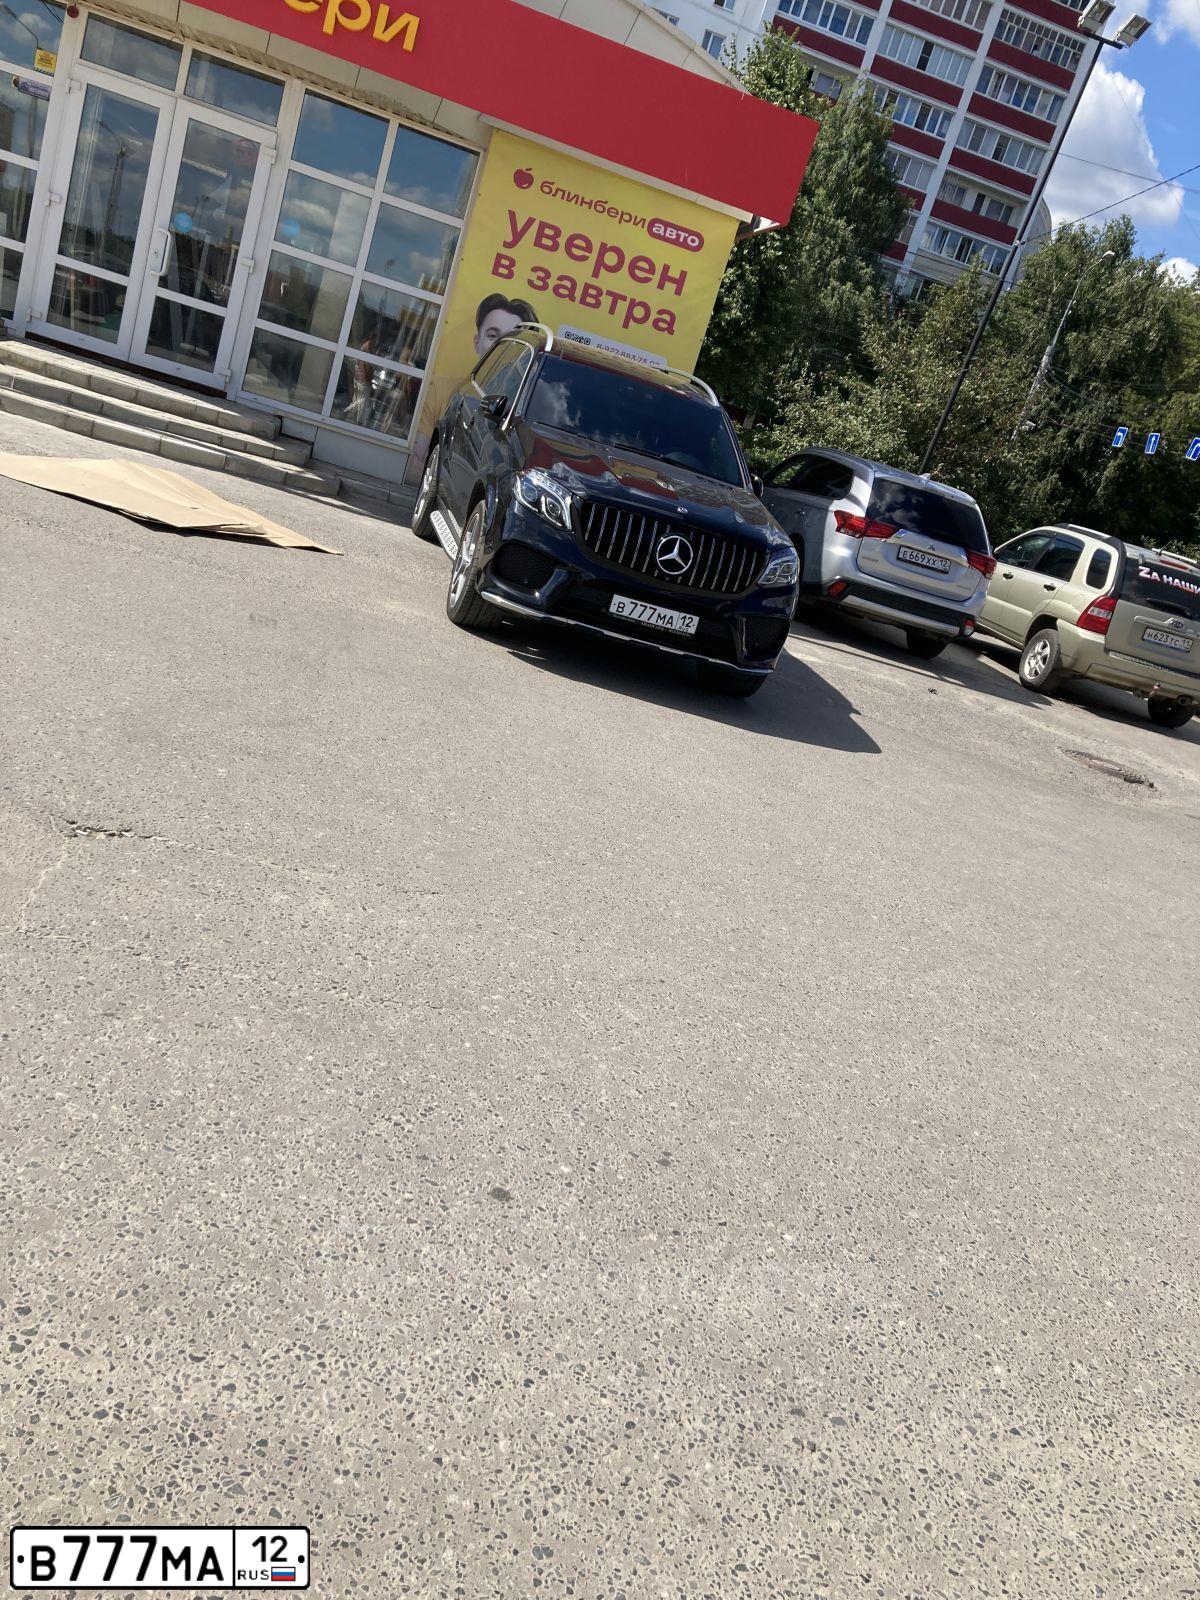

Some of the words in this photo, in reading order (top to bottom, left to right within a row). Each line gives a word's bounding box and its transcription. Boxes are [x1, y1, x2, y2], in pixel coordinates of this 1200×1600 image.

[539, 180, 647, 229] блинбери
[652, 223, 700, 247] авто
[502, 209, 688, 297] уверен
[491, 252, 517, 280] в
[527, 265, 677, 336] завтра
[616, 601, 674, 628] В777МА
[680, 615, 694, 628] 12
